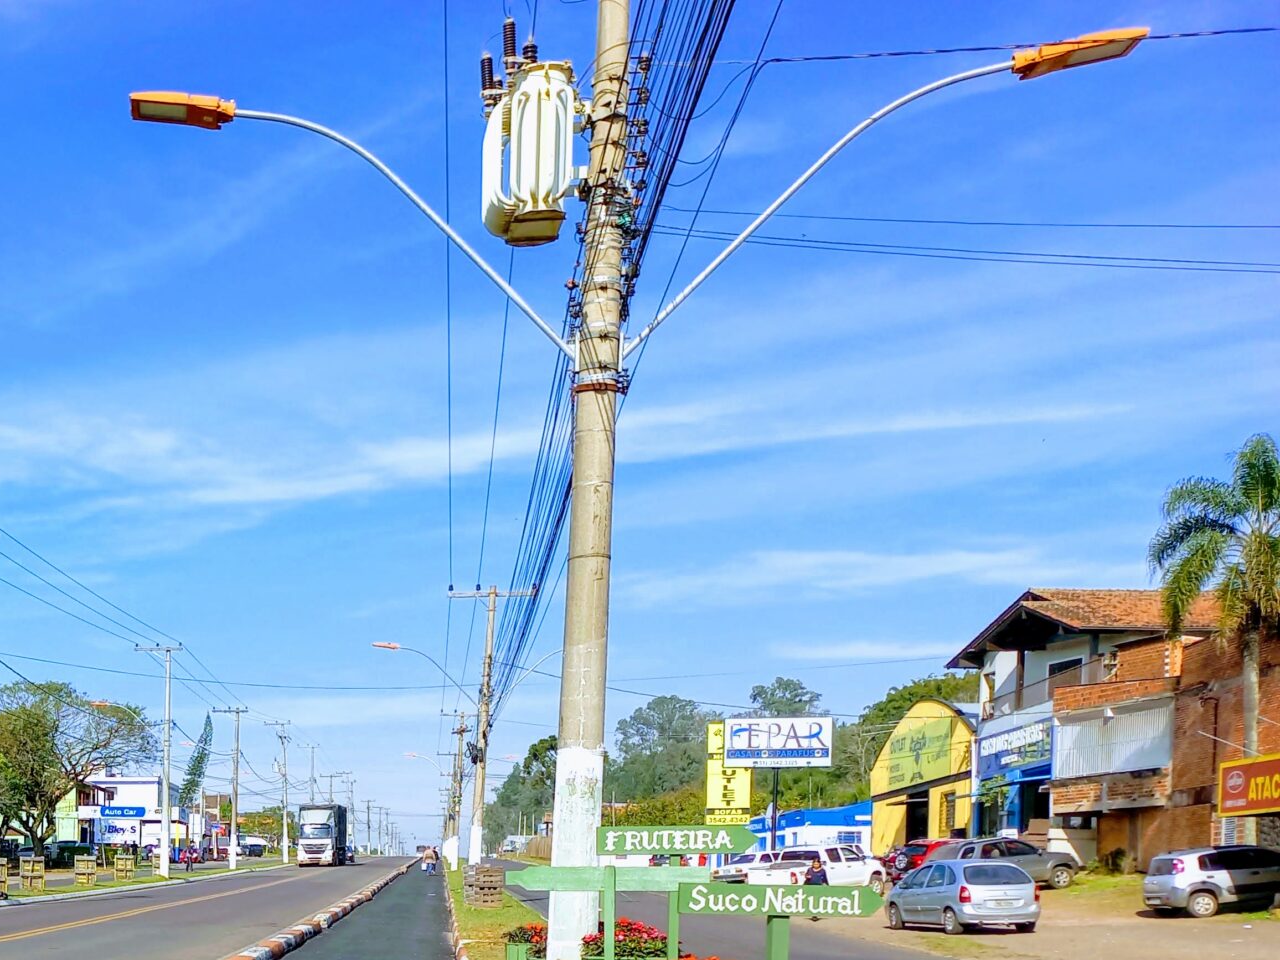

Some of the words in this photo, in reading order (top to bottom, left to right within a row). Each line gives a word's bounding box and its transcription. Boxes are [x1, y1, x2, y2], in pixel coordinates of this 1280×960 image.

[728, 722, 828, 748] FEPAR
[728, 750, 752, 758] CASA
[755, 750, 775, 758] DOS
[776, 749, 828, 758] PARAFUSOS
[721, 768, 736, 806] UTLET
[604, 829, 734, 851] FRUTEIRA
[688, 885, 757, 913] Suco
[761, 887, 862, 915] Natural
